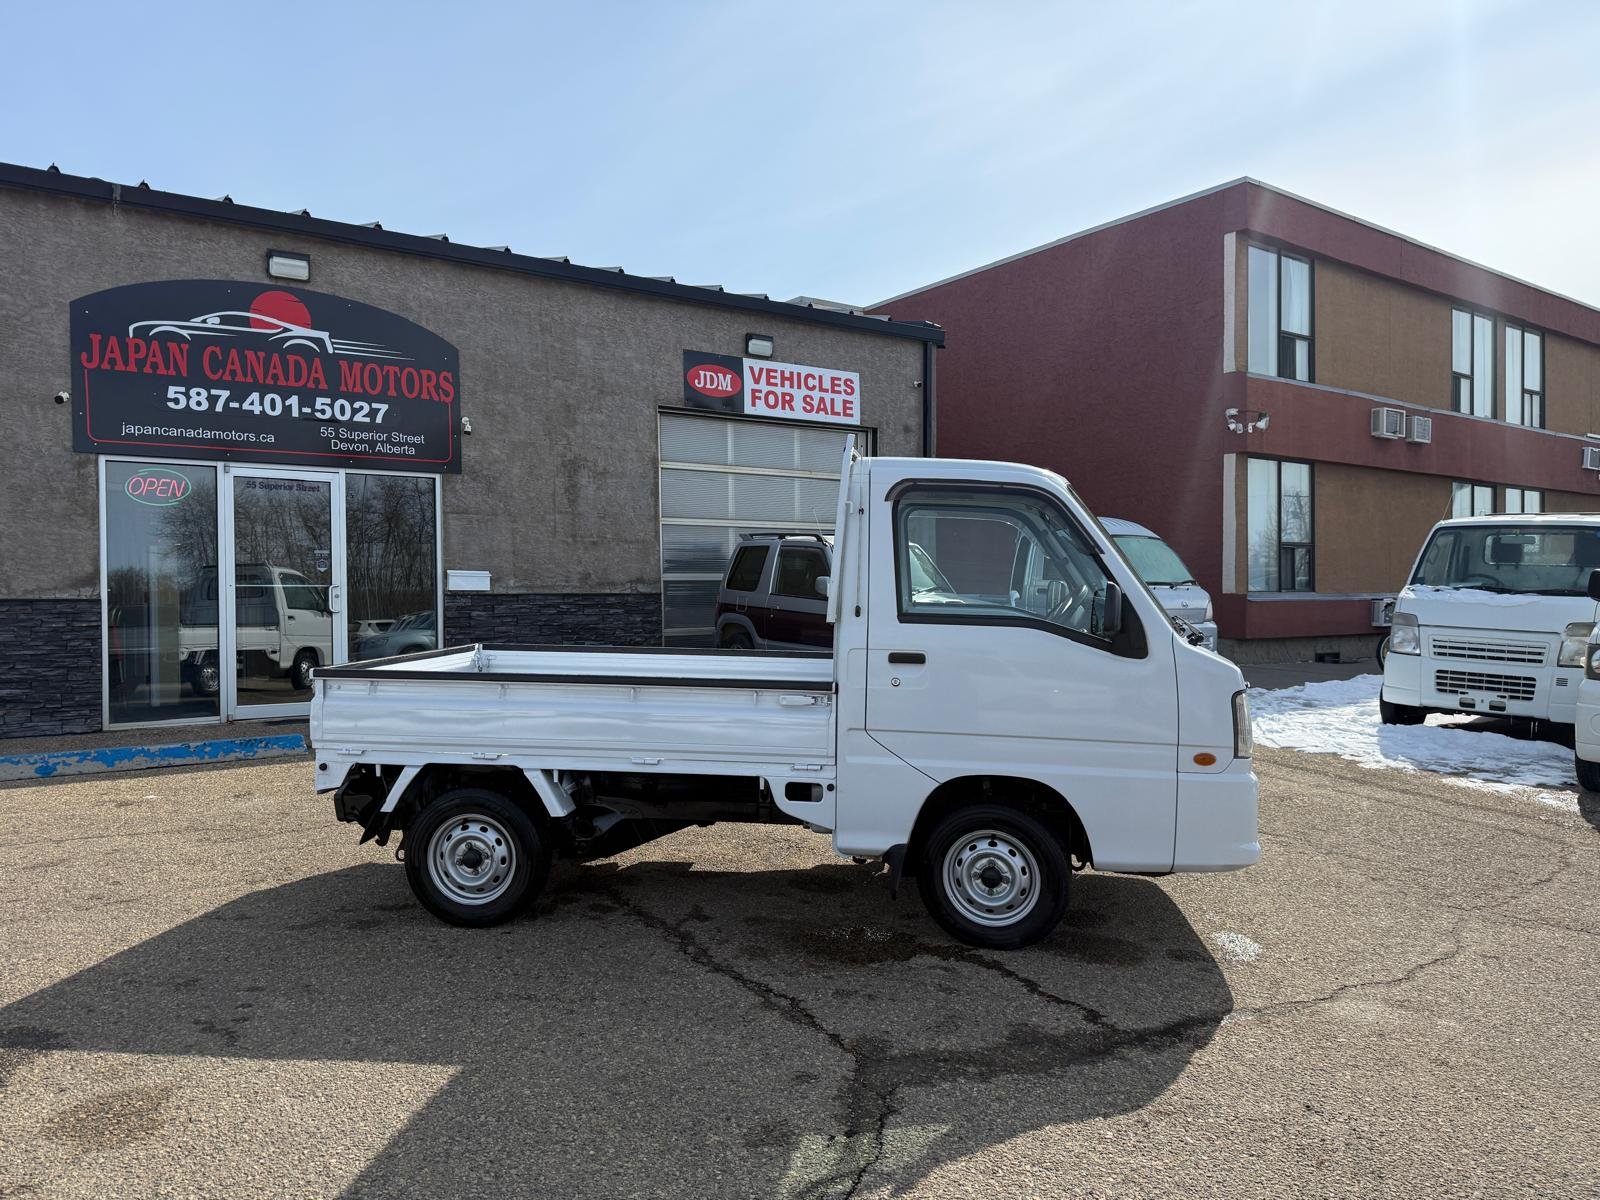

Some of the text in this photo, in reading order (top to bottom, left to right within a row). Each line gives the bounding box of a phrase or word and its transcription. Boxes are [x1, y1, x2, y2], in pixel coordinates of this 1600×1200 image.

[80, 333, 454, 404] JAPAN CANADA MOTORS
[695, 370, 733, 392] JDM
[749, 366, 856, 396] VEHICLES
[166, 385, 389, 424] 587-401-5027
[750, 388, 854, 417] FOR SALE
[121, 422, 275, 443] japancanadamotors.ca
[320, 427, 425, 444] 55 Superior Street
[331, 440, 416, 455] Devon, Alberta
[128, 476, 186, 498] OPEN
[246, 481, 320, 493] 55 Superior Street
